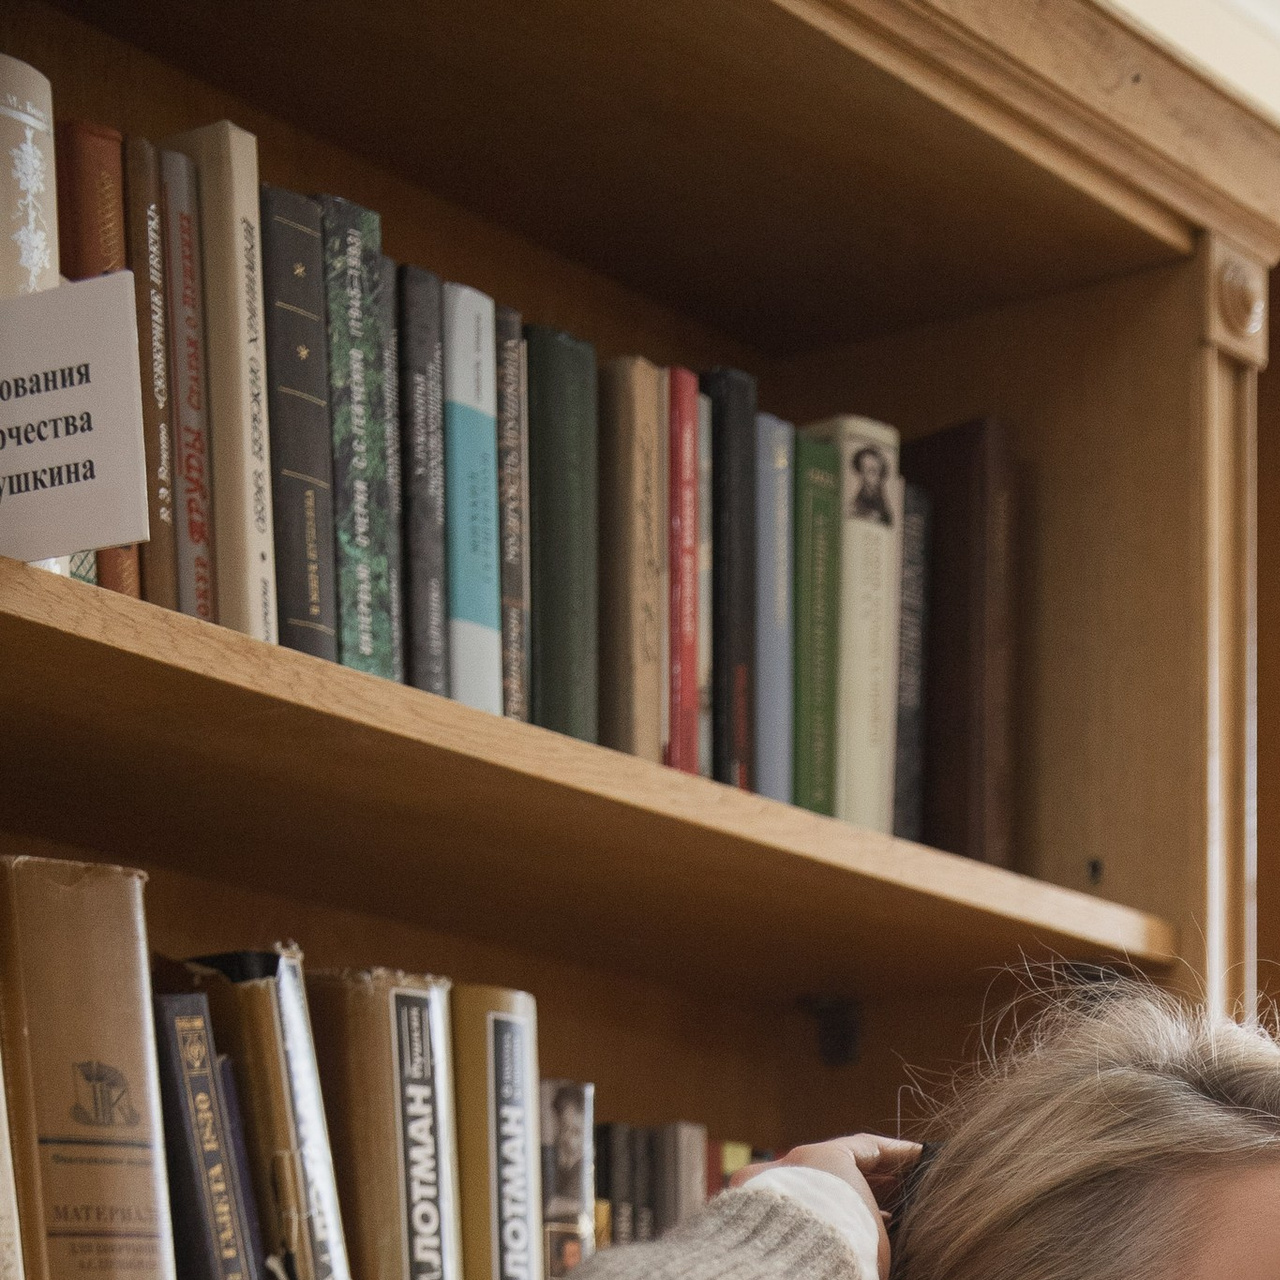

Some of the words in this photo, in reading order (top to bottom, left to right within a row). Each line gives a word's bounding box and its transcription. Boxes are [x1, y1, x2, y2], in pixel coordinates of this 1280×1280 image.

[0, 363, 92, 402] ования
[192, 1091, 220, 1153] 1830
[208, 1163, 238, 1261] ГАЗЕТА
[403, 1083, 443, 1268] ЛОТМАН
